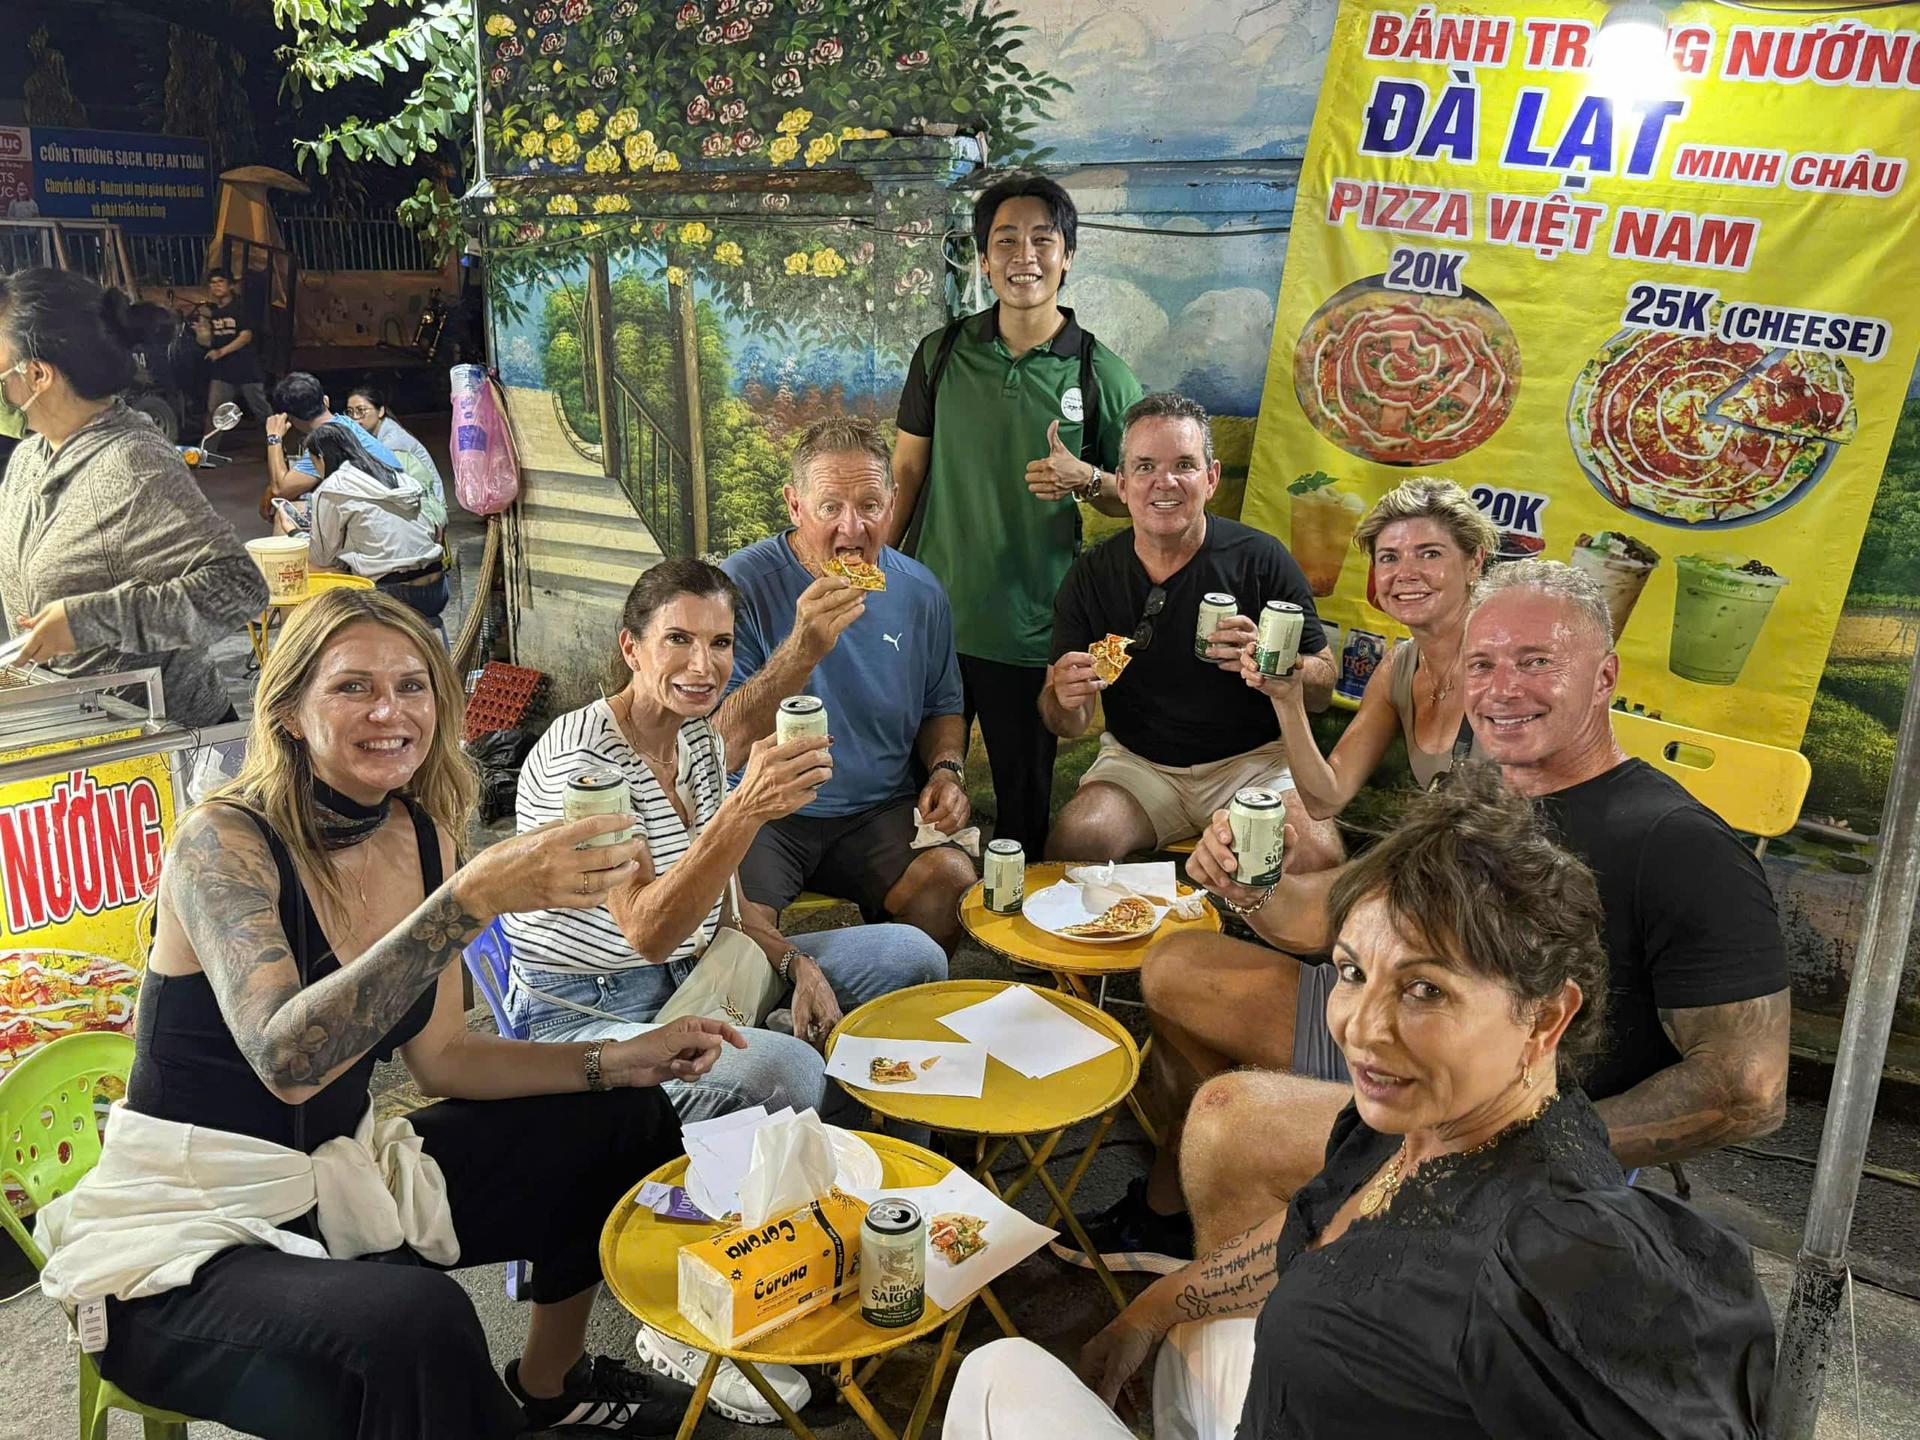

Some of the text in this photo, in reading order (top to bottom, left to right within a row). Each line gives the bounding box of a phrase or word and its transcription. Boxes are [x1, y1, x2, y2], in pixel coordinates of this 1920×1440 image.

[1368, 9, 1509, 63] BÁNH
[1528, 22, 1711, 73] TRG
[1362, 70, 1902, 192] ĐÀ LẠT MINH CHÂU
[1329, 182, 1755, 267] PIZZA VIỆT NAM
[1388, 249, 1464, 292] 20K
[1625, 285, 1886, 357] 25K (CHEESE)
[1471, 488, 1544, 533] 20K
[0, 771, 163, 928] NƯỚNG
[725, 1219, 795, 1259] Corona
[754, 1264, 807, 1300] Corona
[871, 1284, 921, 1303] SAIGON
[889, 1284, 906, 1292] BIA
